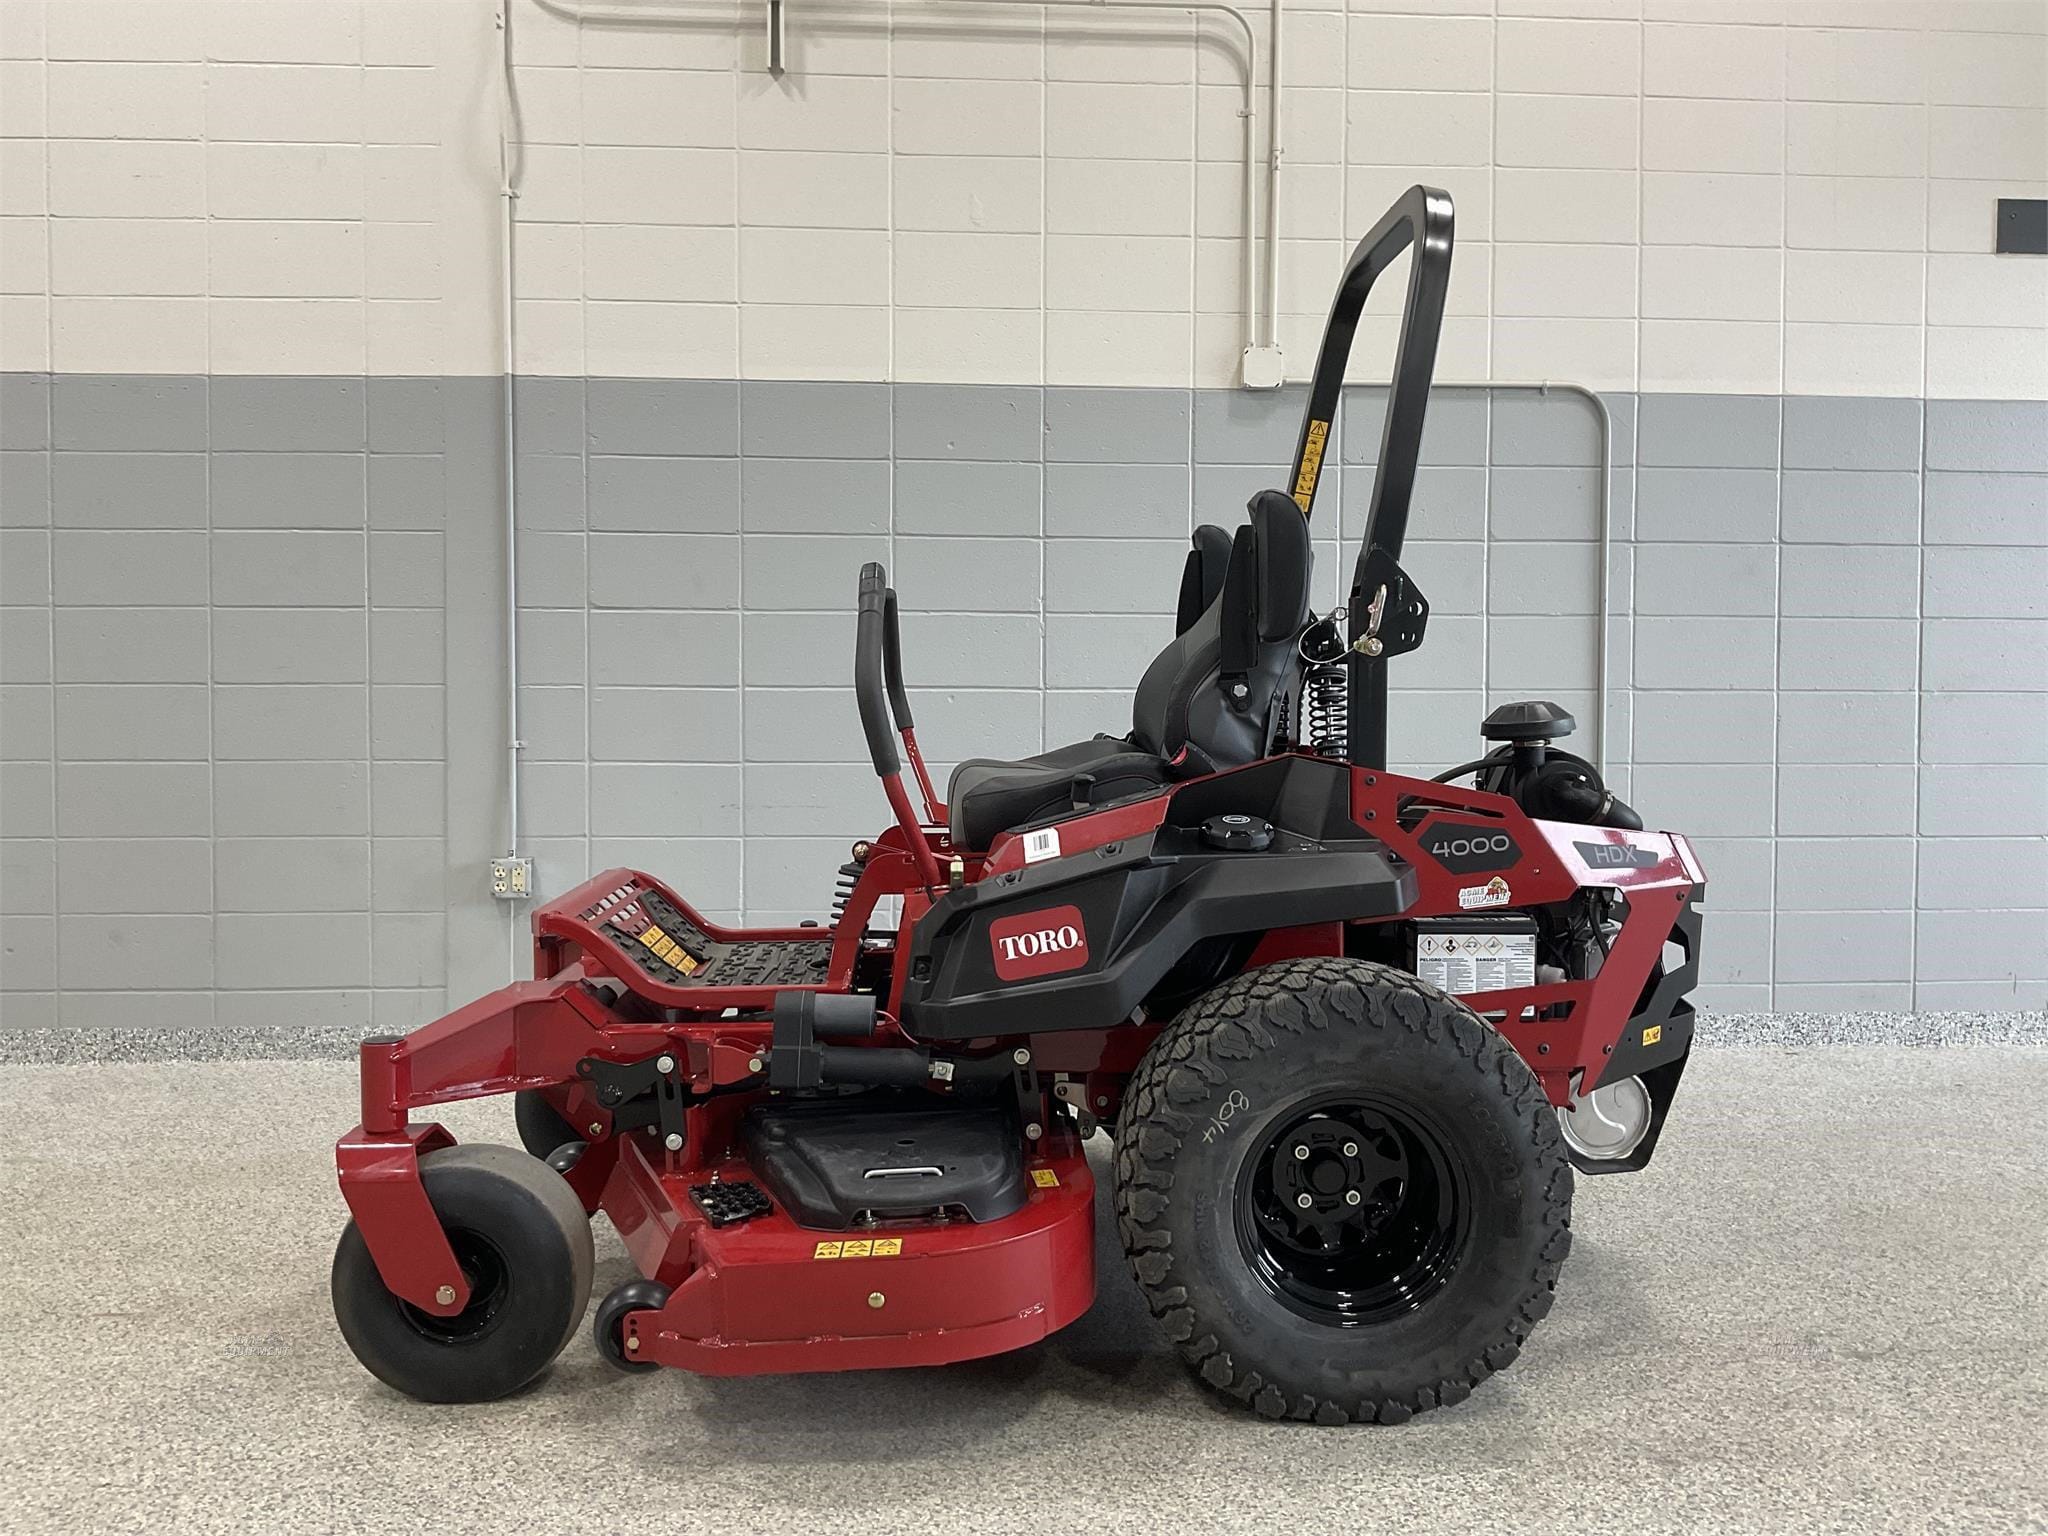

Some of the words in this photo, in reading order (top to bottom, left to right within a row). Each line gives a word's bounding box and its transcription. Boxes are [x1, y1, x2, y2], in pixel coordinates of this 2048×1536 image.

[1432, 835, 1510, 858] 4000
[1594, 846, 1638, 863] HDX
[999, 925, 1079, 960] TORO
